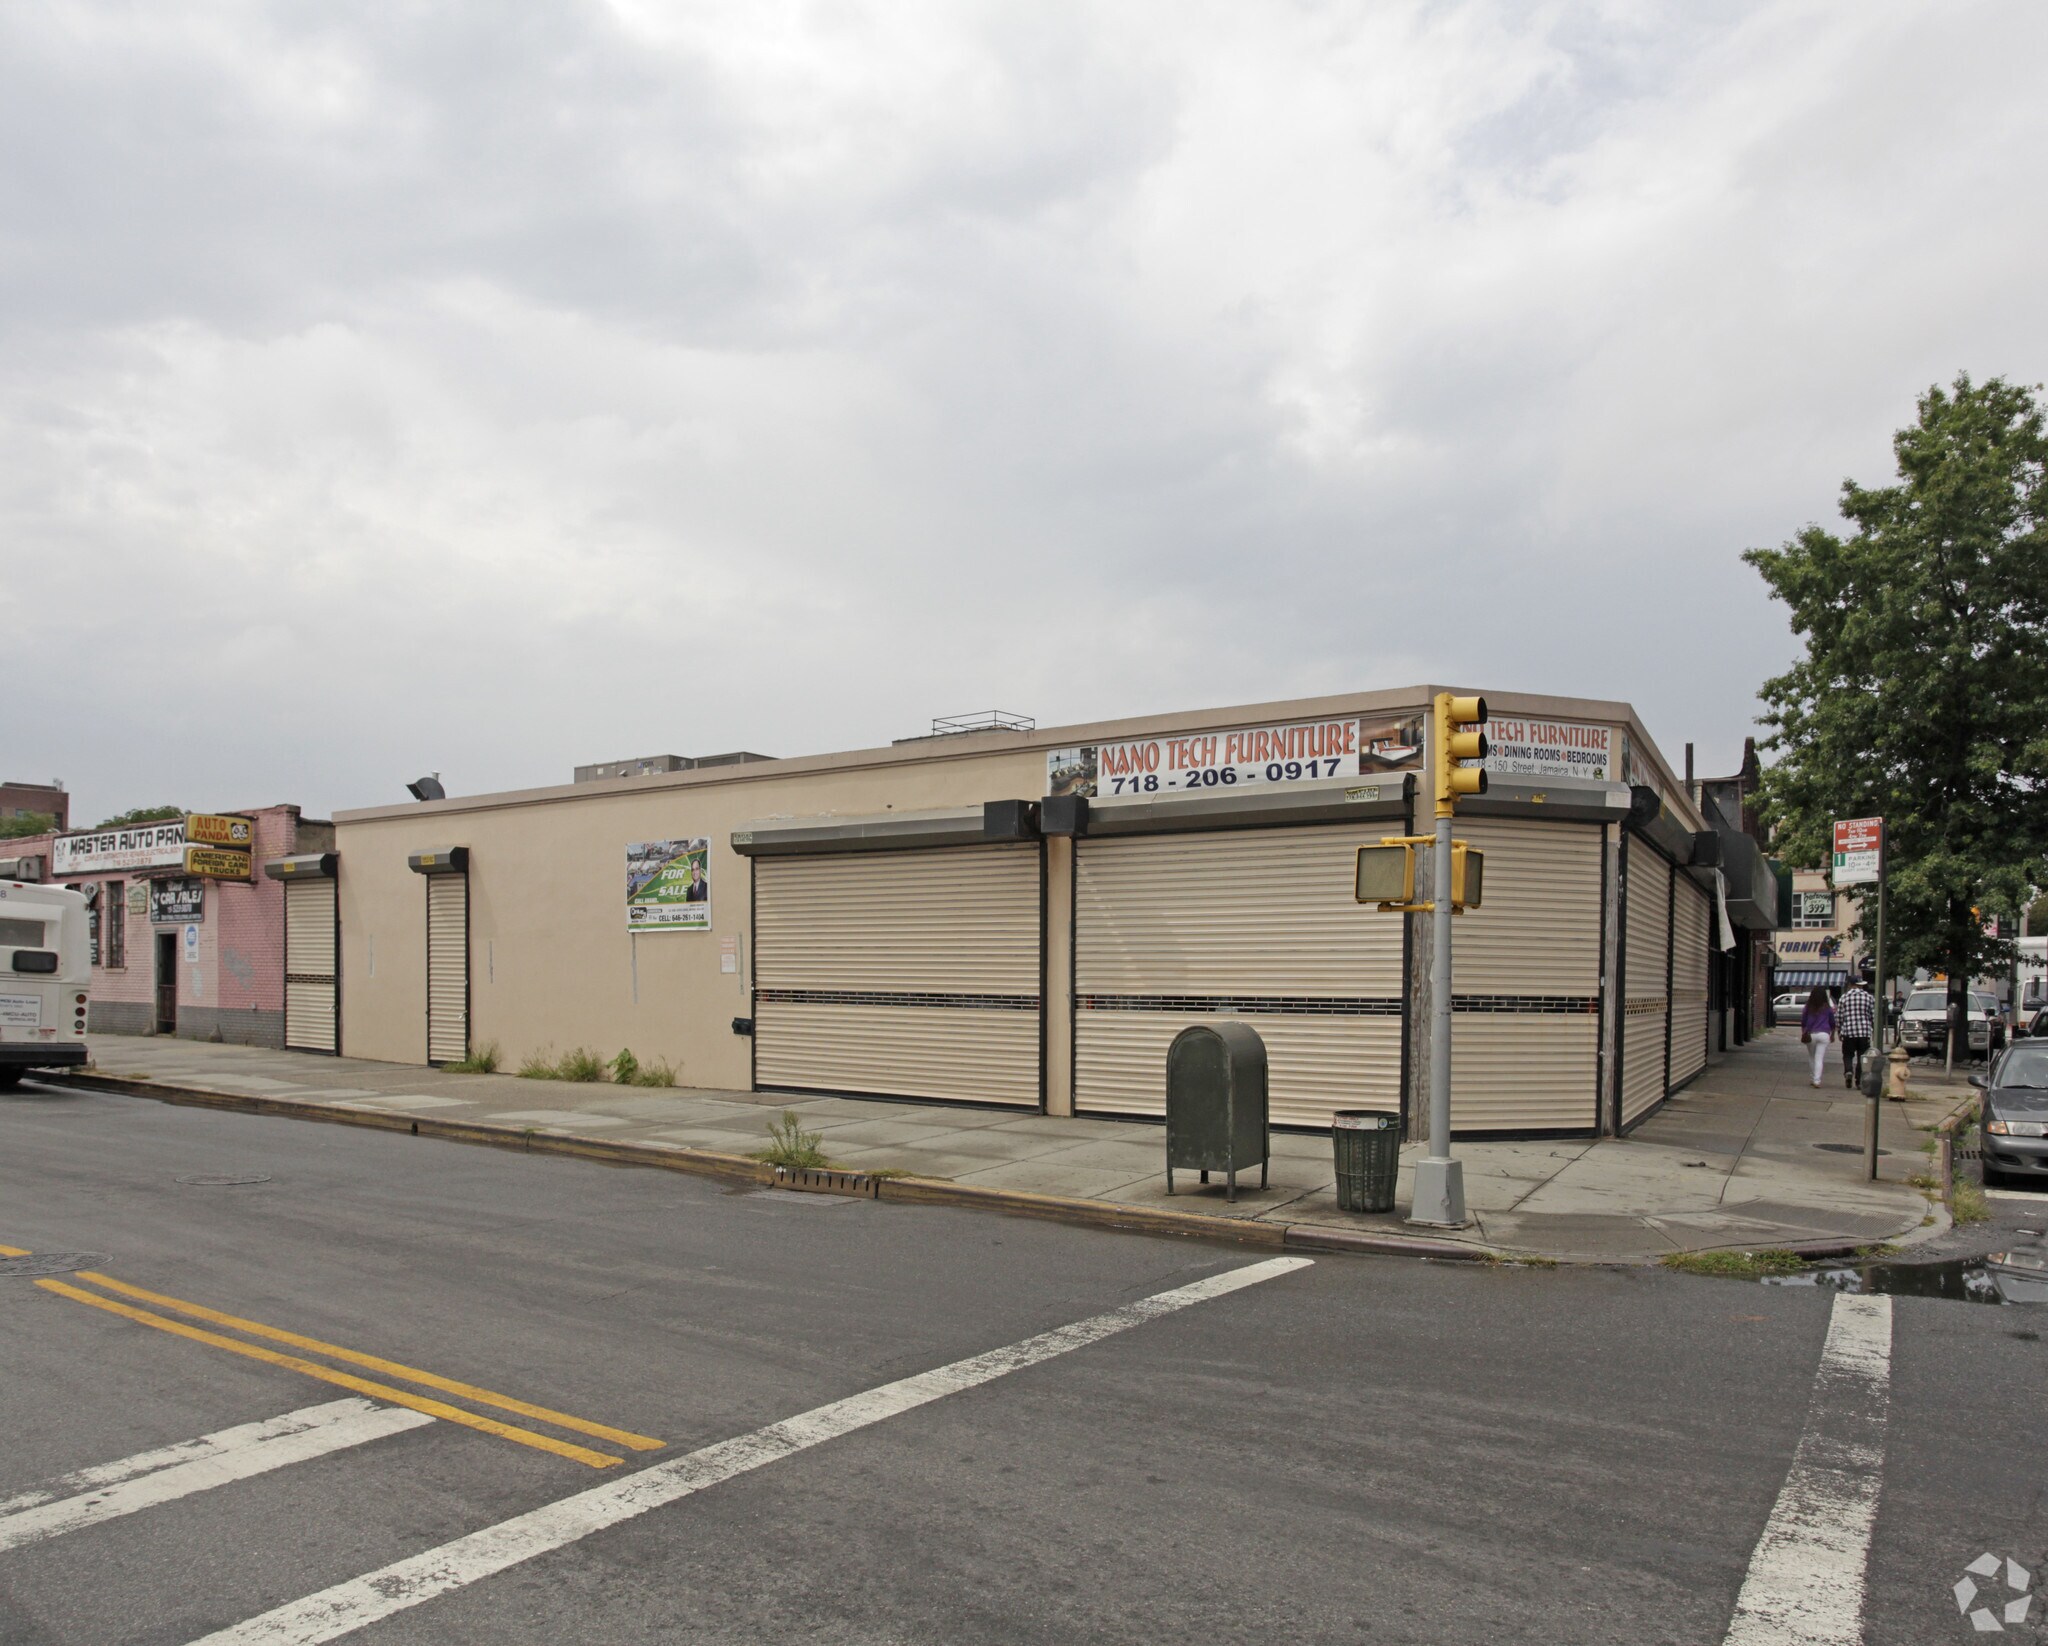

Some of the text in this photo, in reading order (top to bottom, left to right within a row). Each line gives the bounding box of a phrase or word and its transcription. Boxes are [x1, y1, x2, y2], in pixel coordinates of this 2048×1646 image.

[1488, 721, 1608, 750] TECH FURNITURE
[1101, 722, 1356, 777] NANO TECH FURNITURE
[1504, 745, 1532, 759] DINING
[1533, 747, 1560, 761] ROOMS
[1567, 751, 1607, 766] BEDROOMS
[1494, 760, 1507, 772] 150
[1111, 775, 1159, 795] 718
[1185, 767, 1237, 788] 206
[1266, 758, 1341, 781] 0917
[196, 817, 226, 831] AUTO
[1849, 820, 1879, 828] STANDING
[194, 830, 230, 841] PANDA
[70, 834, 116, 855] MASTER
[120, 831, 153, 850] AUTO
[193, 859, 225, 867] FOREIGN
[209, 867, 240, 875] TRUCKS
[661, 869, 685, 880] FOR
[658, 885, 689, 896] SALE
[160, 892, 176, 905] CAR
